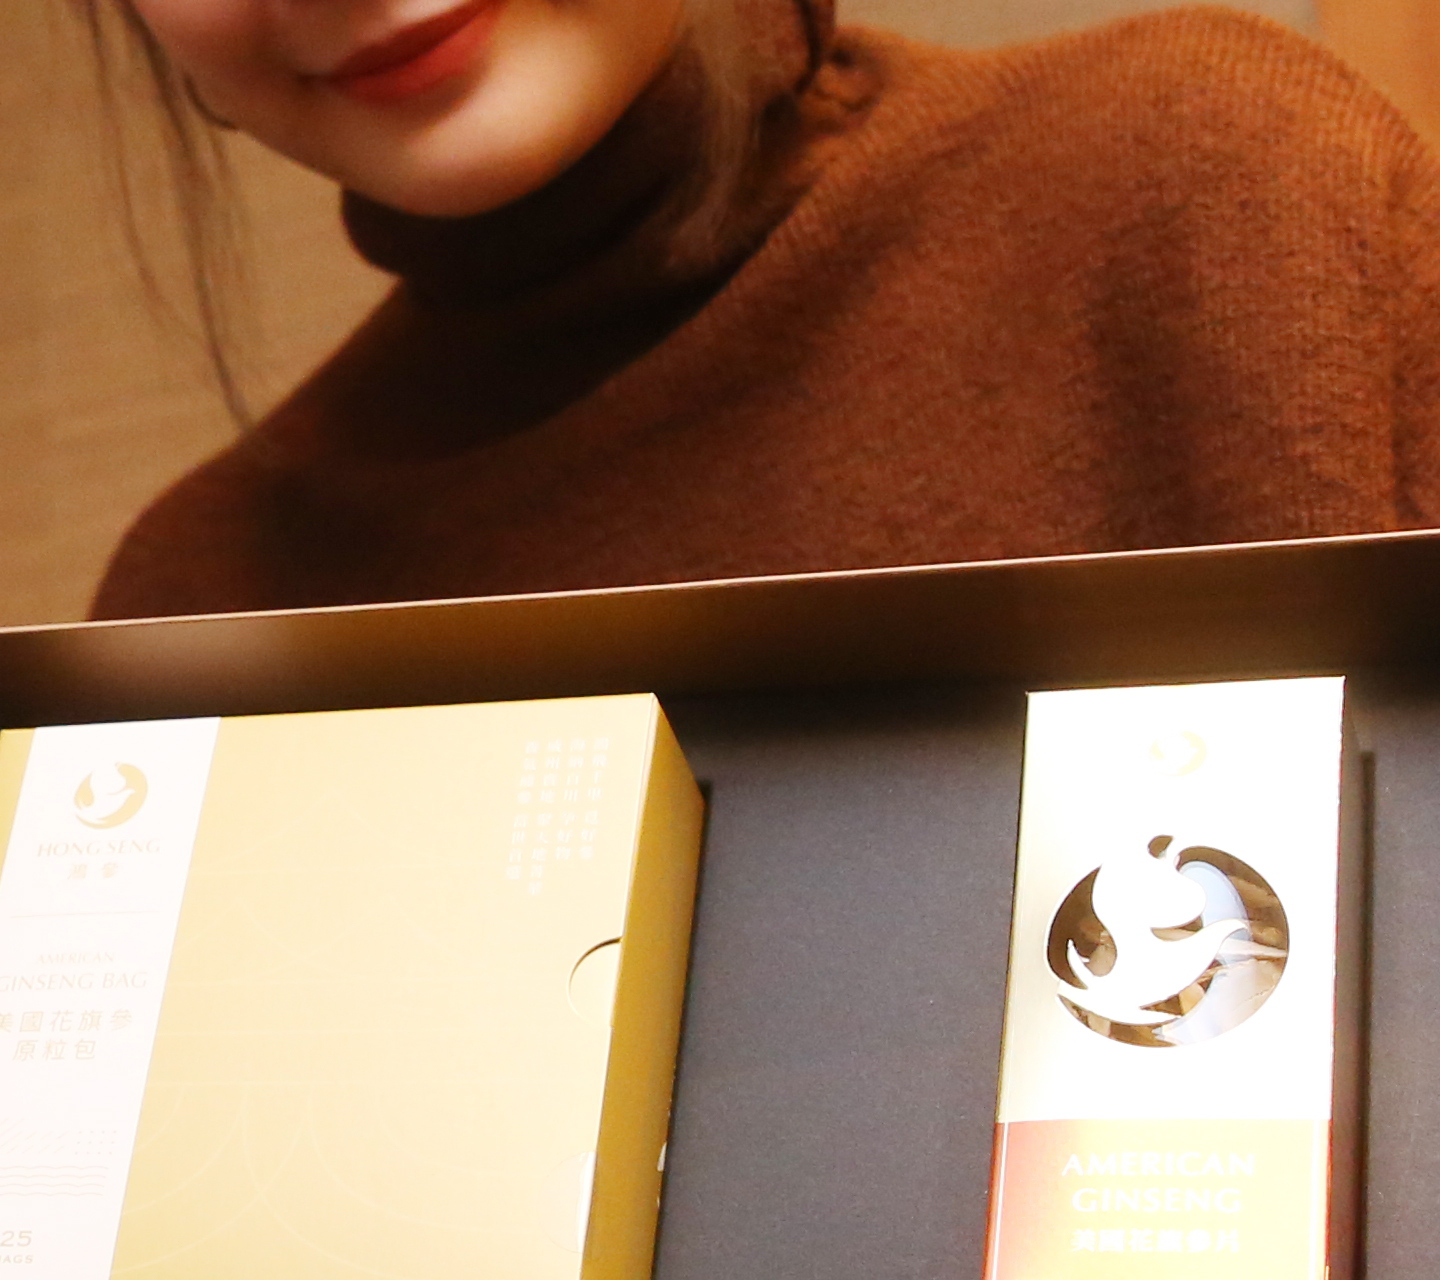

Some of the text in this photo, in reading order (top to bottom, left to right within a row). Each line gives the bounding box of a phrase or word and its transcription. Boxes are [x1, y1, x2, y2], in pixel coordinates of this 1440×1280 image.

[37, 839, 160, 857] HONG SENG
[37, 952, 115, 964] AMERICAN
[102, 972, 148, 989] BAG
[13, 1039, 96, 1061] 原粒包
[1061, 1152, 1256, 1176] AMERICAN
[1071, 1187, 1242, 1213] GINSENG
[0, 1230, 32, 1247] 25
